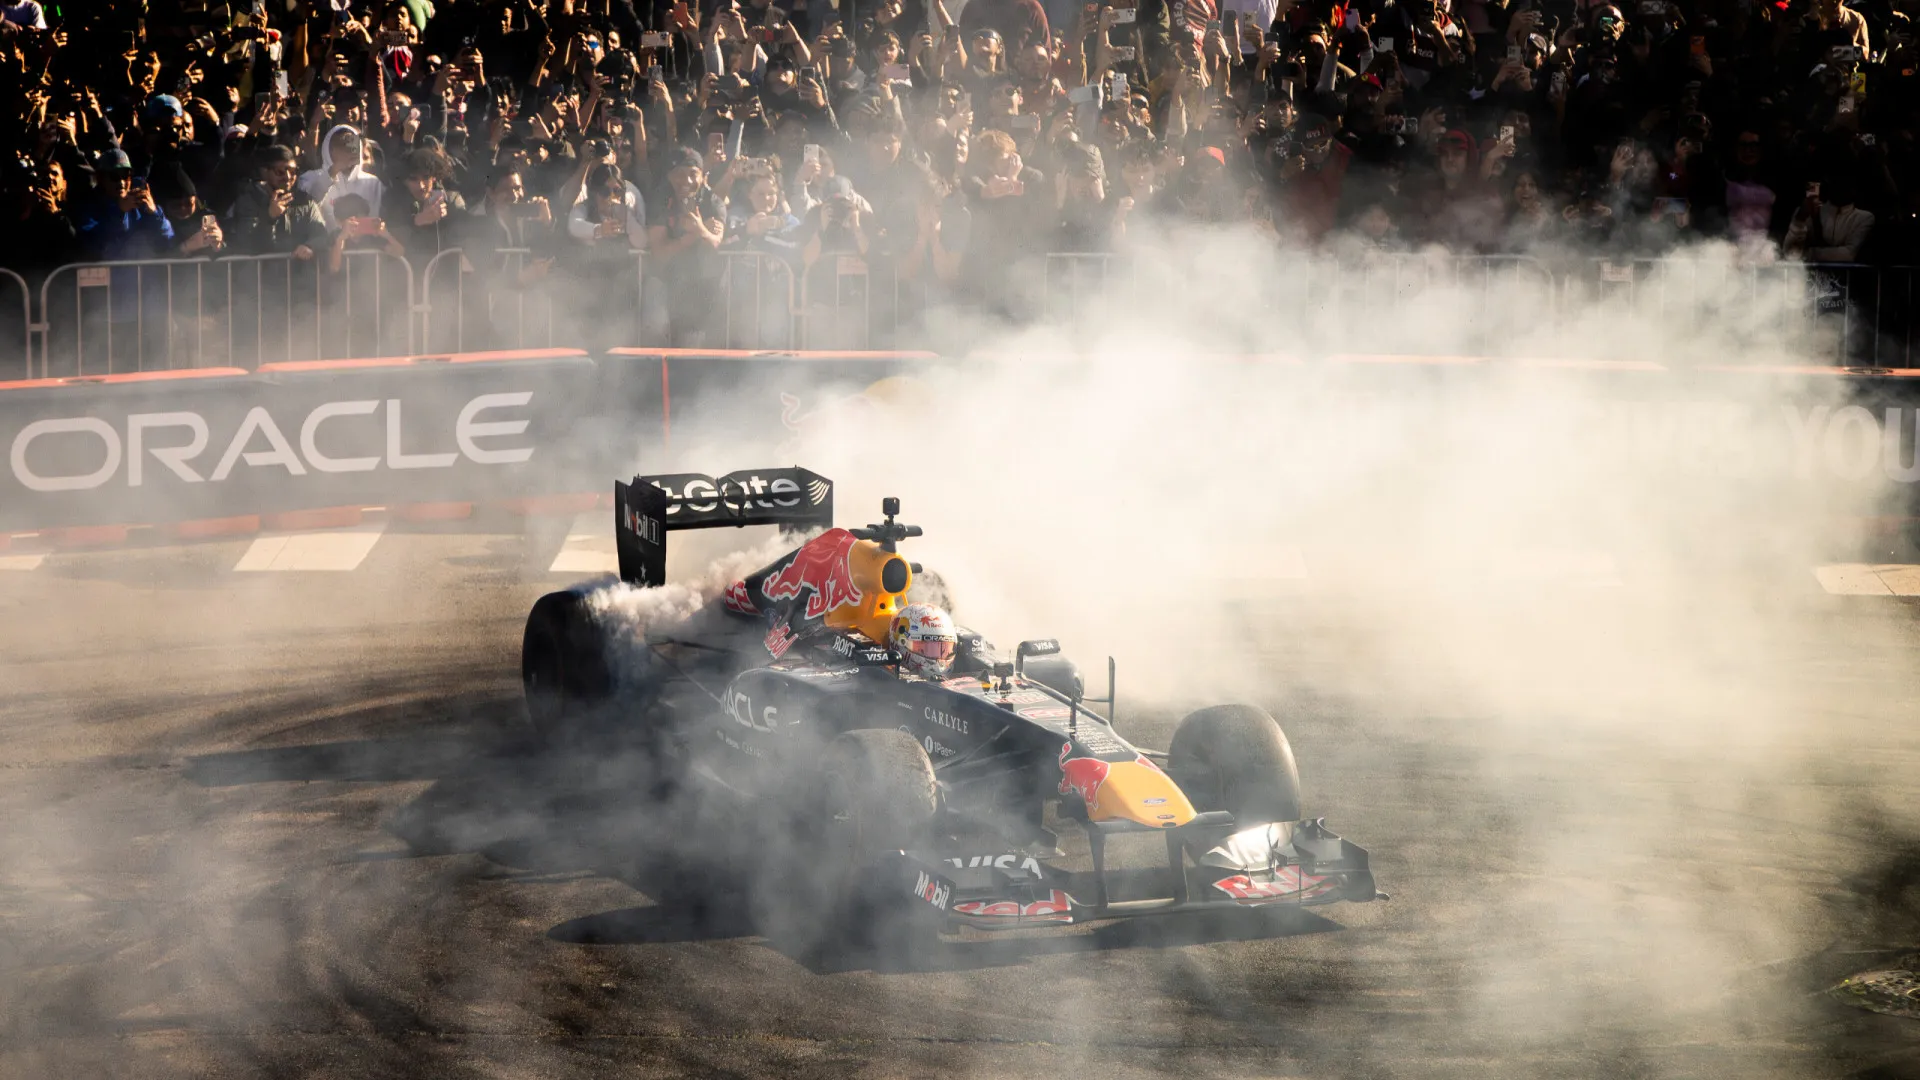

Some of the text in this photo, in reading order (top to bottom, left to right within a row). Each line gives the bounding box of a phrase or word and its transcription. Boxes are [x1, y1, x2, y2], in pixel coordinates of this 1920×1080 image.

[10, 391, 534, 492] ORACLE
[1780, 404, 1920, 483] YOU
[865, 653, 889, 661] VISA
[1034, 641, 1054, 651] VISA
[924, 706, 969, 735] CARLYLE
[914, 870, 950, 911] Mobil
